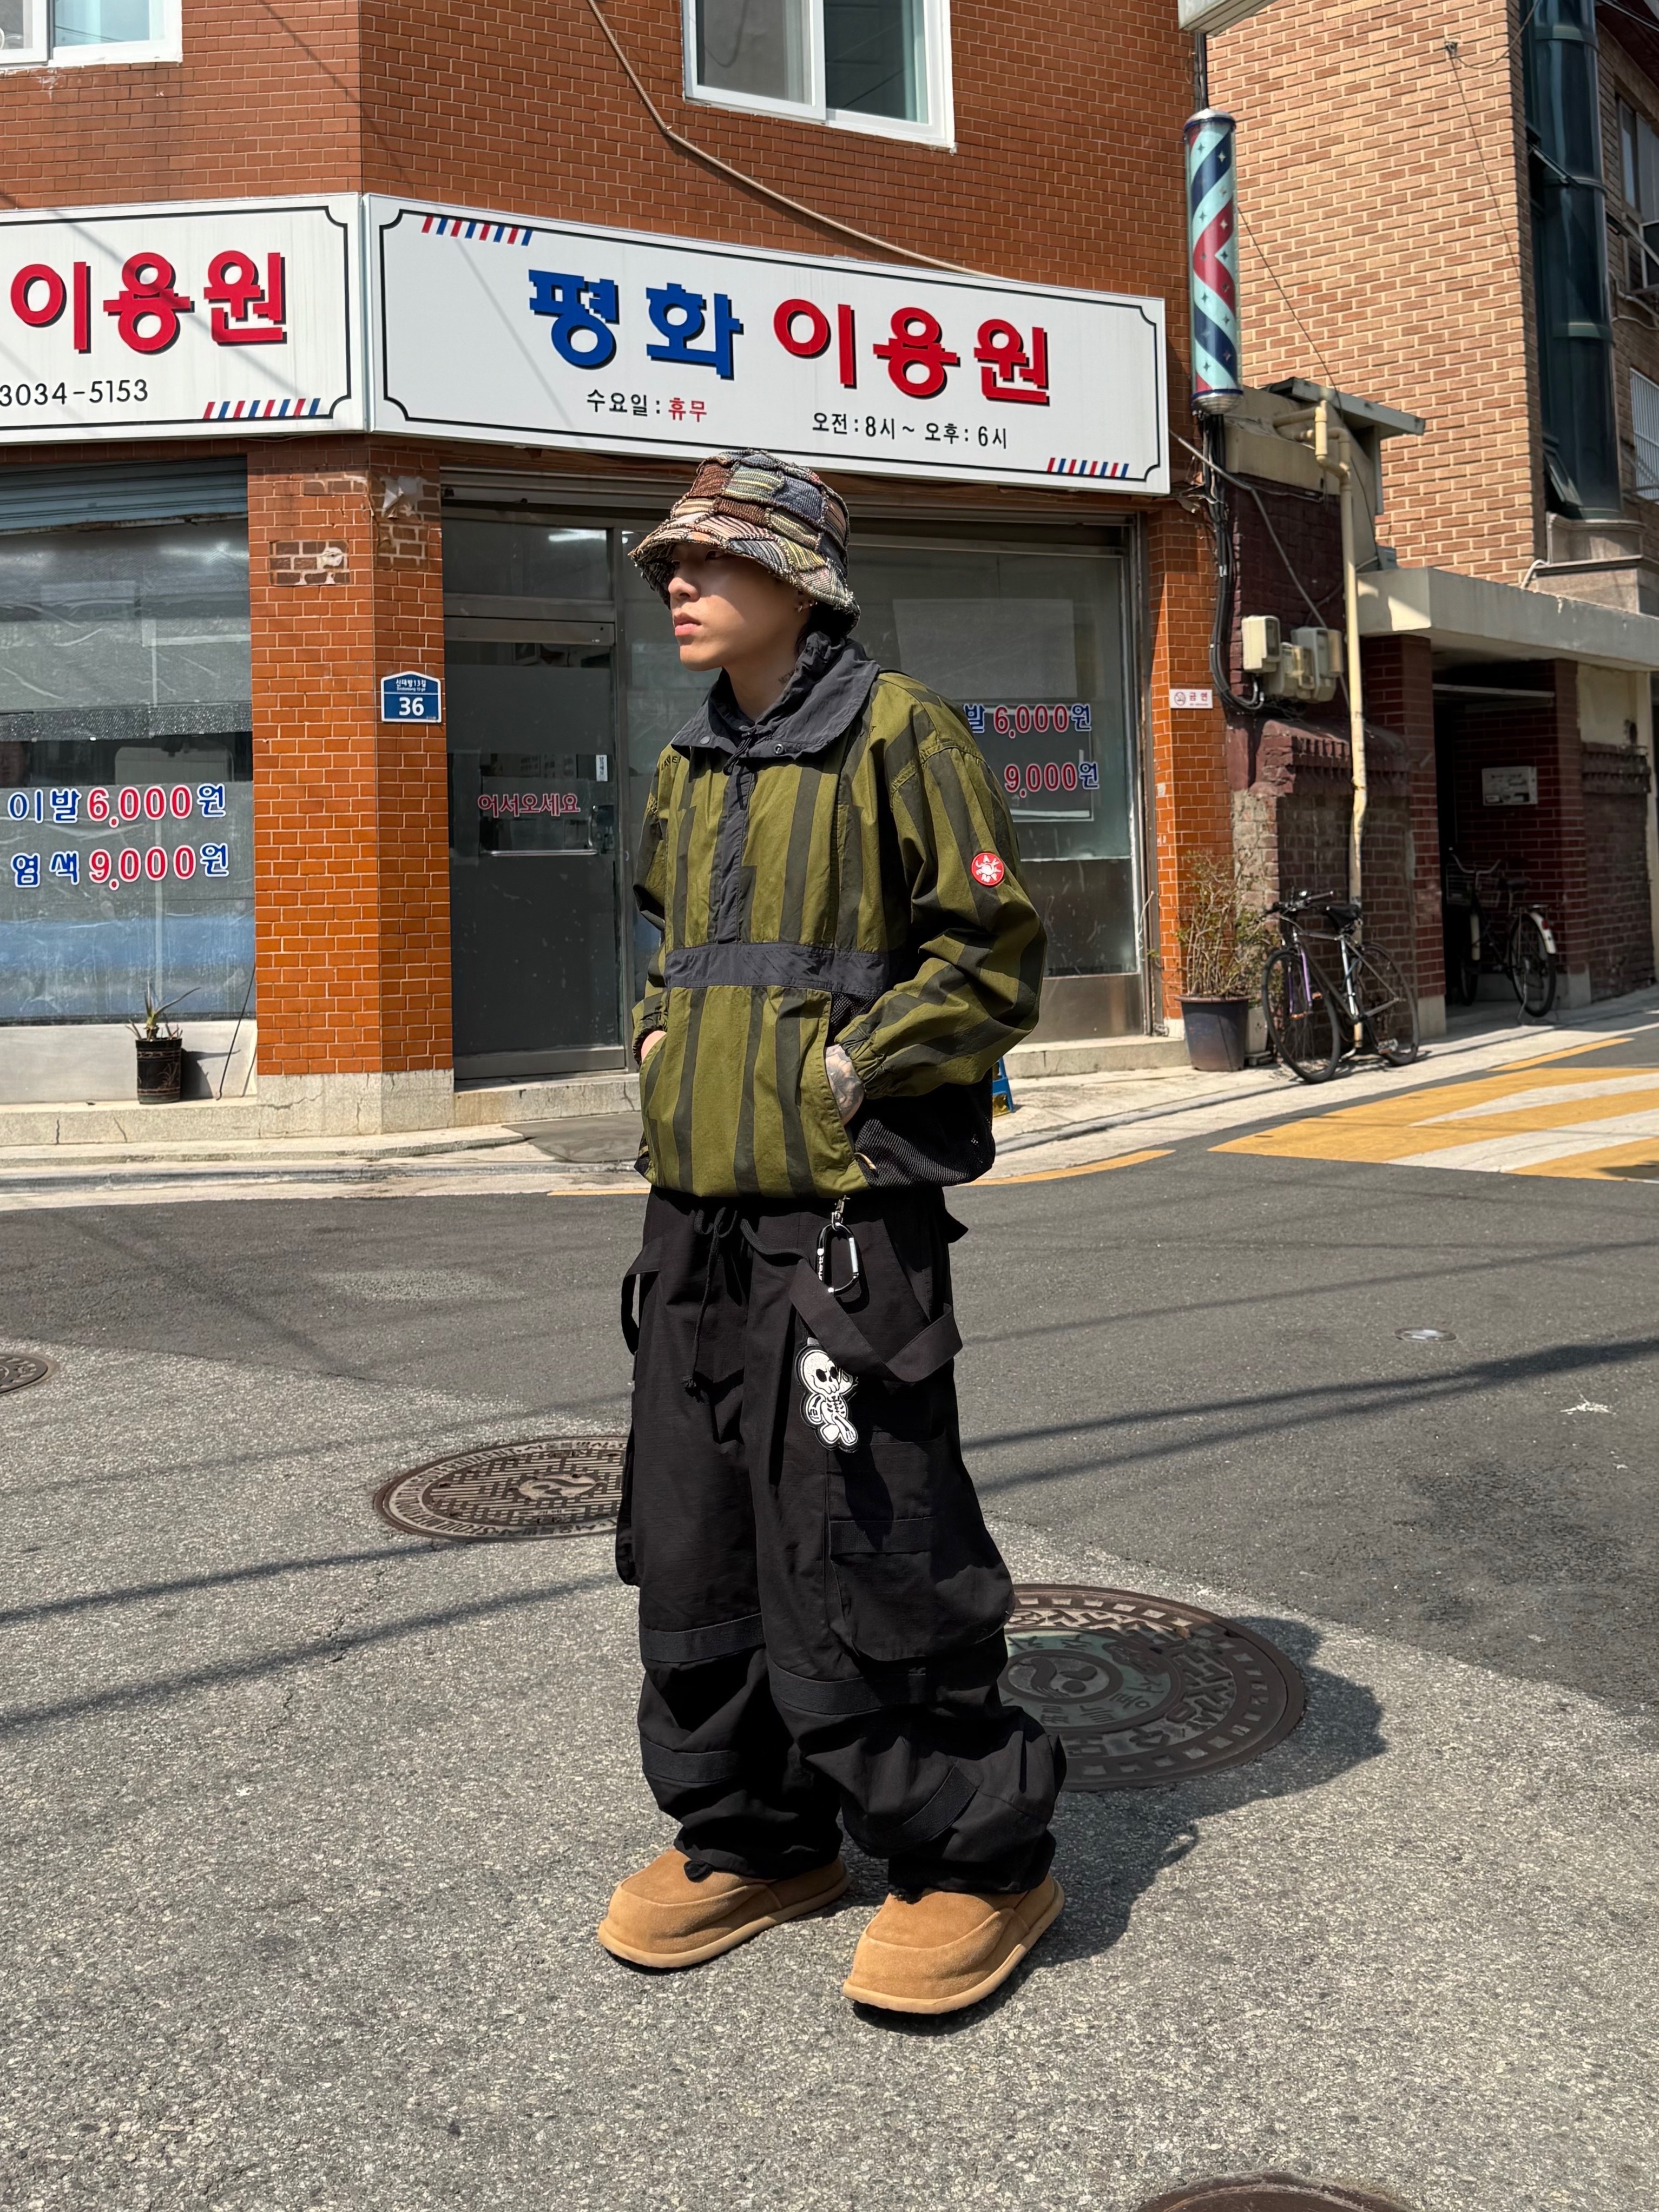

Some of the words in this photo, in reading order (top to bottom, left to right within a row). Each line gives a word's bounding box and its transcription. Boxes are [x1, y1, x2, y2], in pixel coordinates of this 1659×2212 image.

[11, 250, 287, 355] 이용원
[528, 269, 743, 381] 평화
[773, 298, 1050, 406] 이용원
[0, 379, 148, 407] 3034-5153
[399, 697, 424, 716] 36
[8, 788, 81, 823] 이발
[478, 793, 581, 818] 어서오세요
[11, 850, 80, 888] 염색
